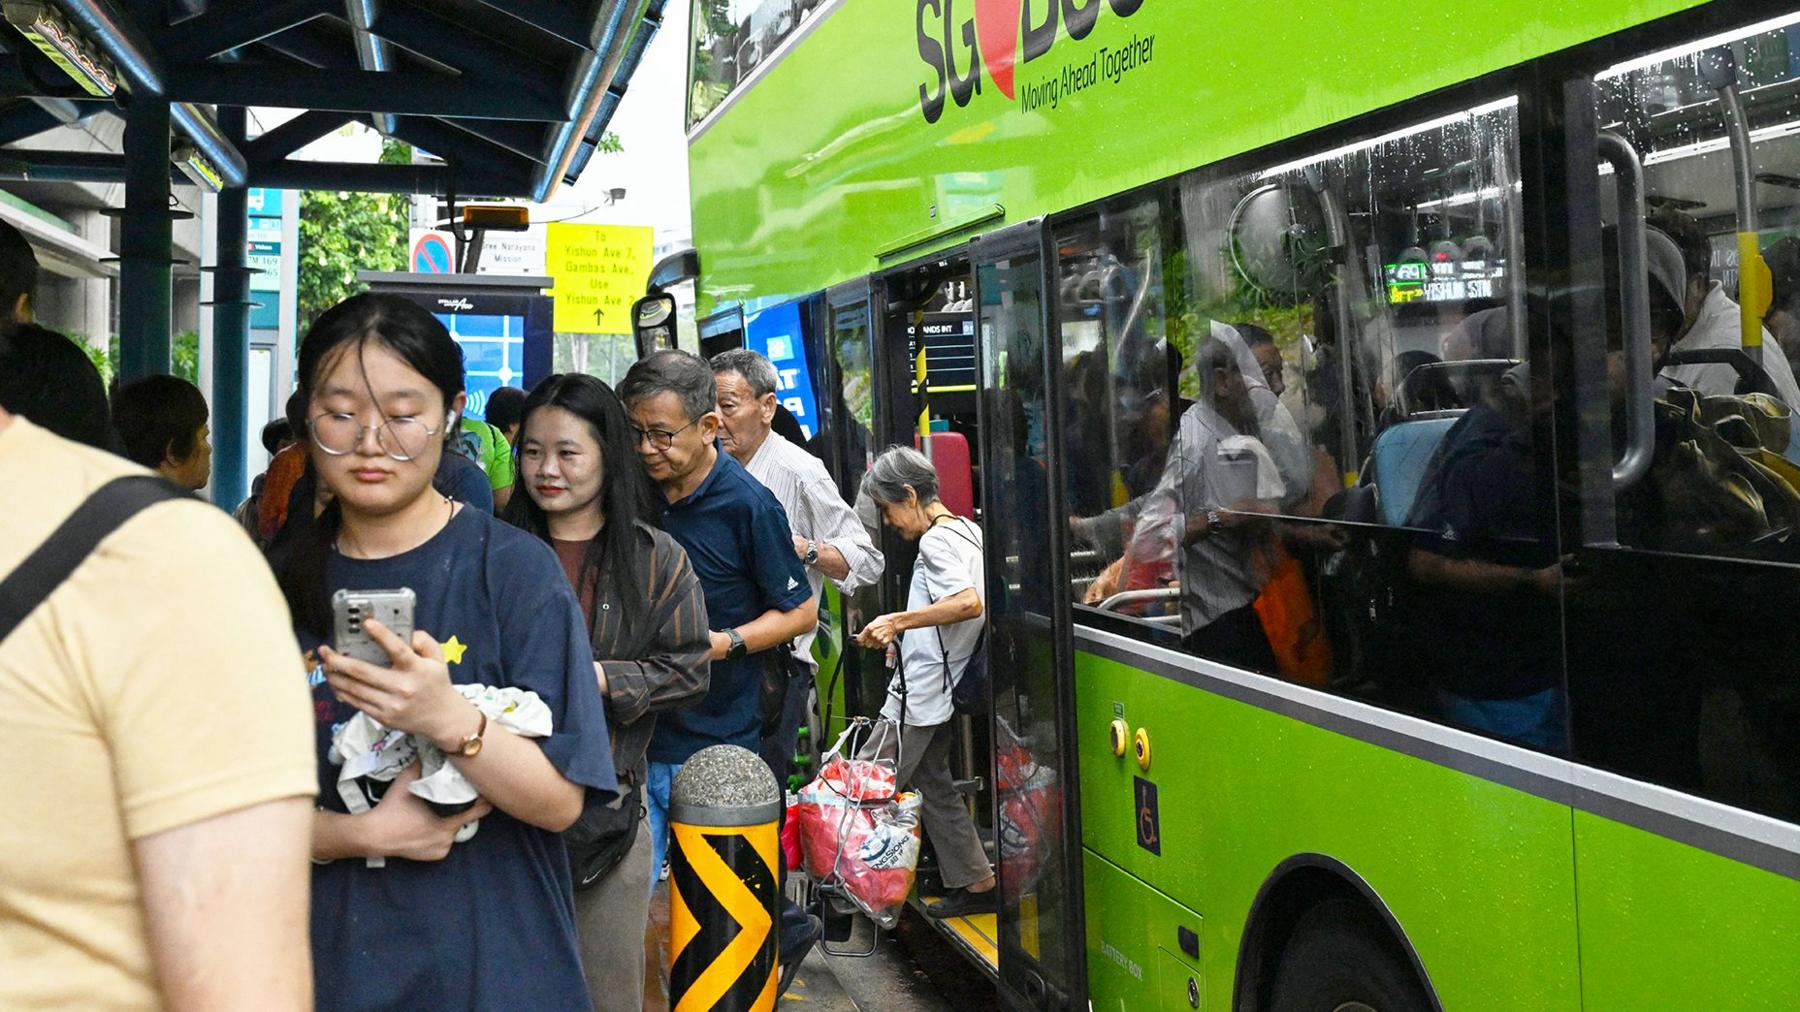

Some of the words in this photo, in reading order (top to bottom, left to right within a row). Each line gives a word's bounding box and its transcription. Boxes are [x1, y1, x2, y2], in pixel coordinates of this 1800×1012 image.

[916, 0, 982, 124] SG
[1021, 76, 1059, 114] Moving
[1060, 53, 1098, 99] Ahead
[1100, 34, 1156, 86] Together
[565, 246, 598, 257] Yishun
[603, 247, 621, 258] Ave
[565, 261, 606, 273] Gambas
[590, 279, 609, 289] Use
[566, 294, 599, 305] Yishun
[604, 296, 622, 306] Ave
